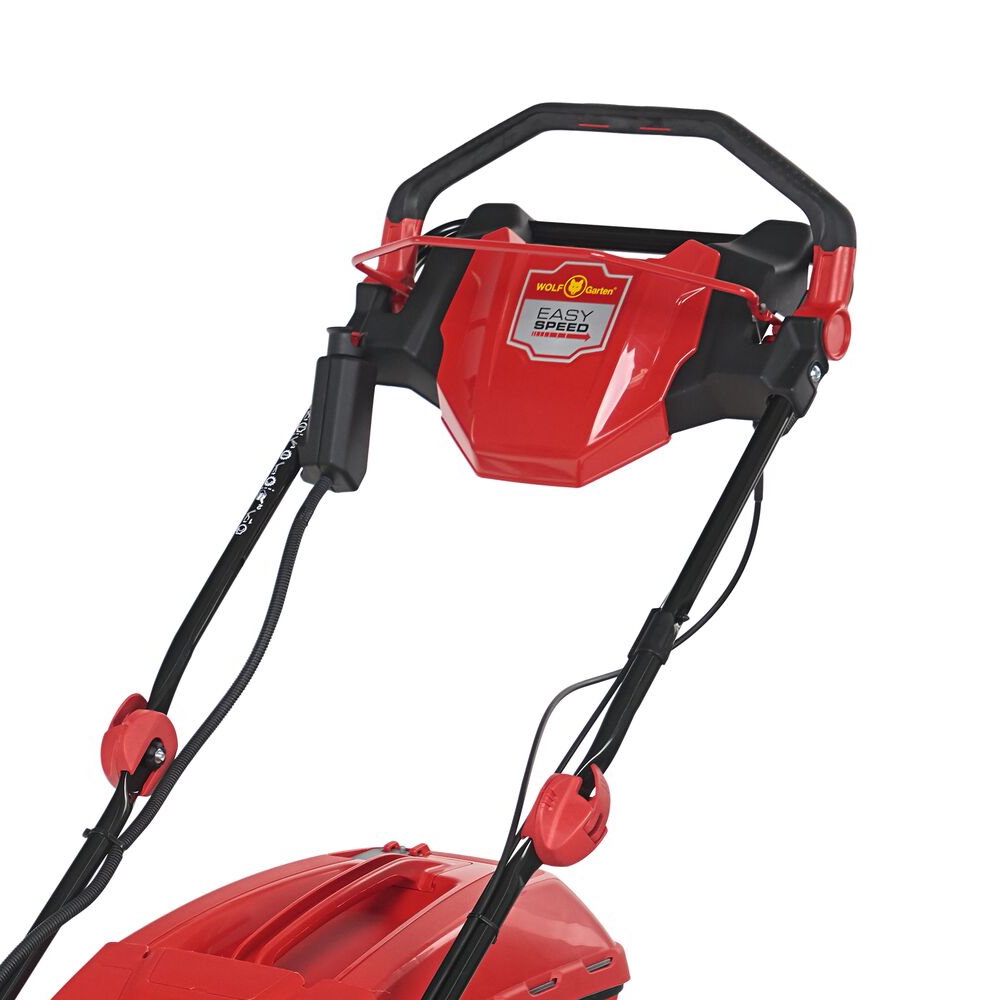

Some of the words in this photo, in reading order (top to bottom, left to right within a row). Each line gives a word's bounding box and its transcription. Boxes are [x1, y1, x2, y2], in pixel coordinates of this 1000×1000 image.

[536, 283, 564, 292] WOLF
[537, 307, 594, 322] EASY
[534, 321, 589, 333] SPEED
